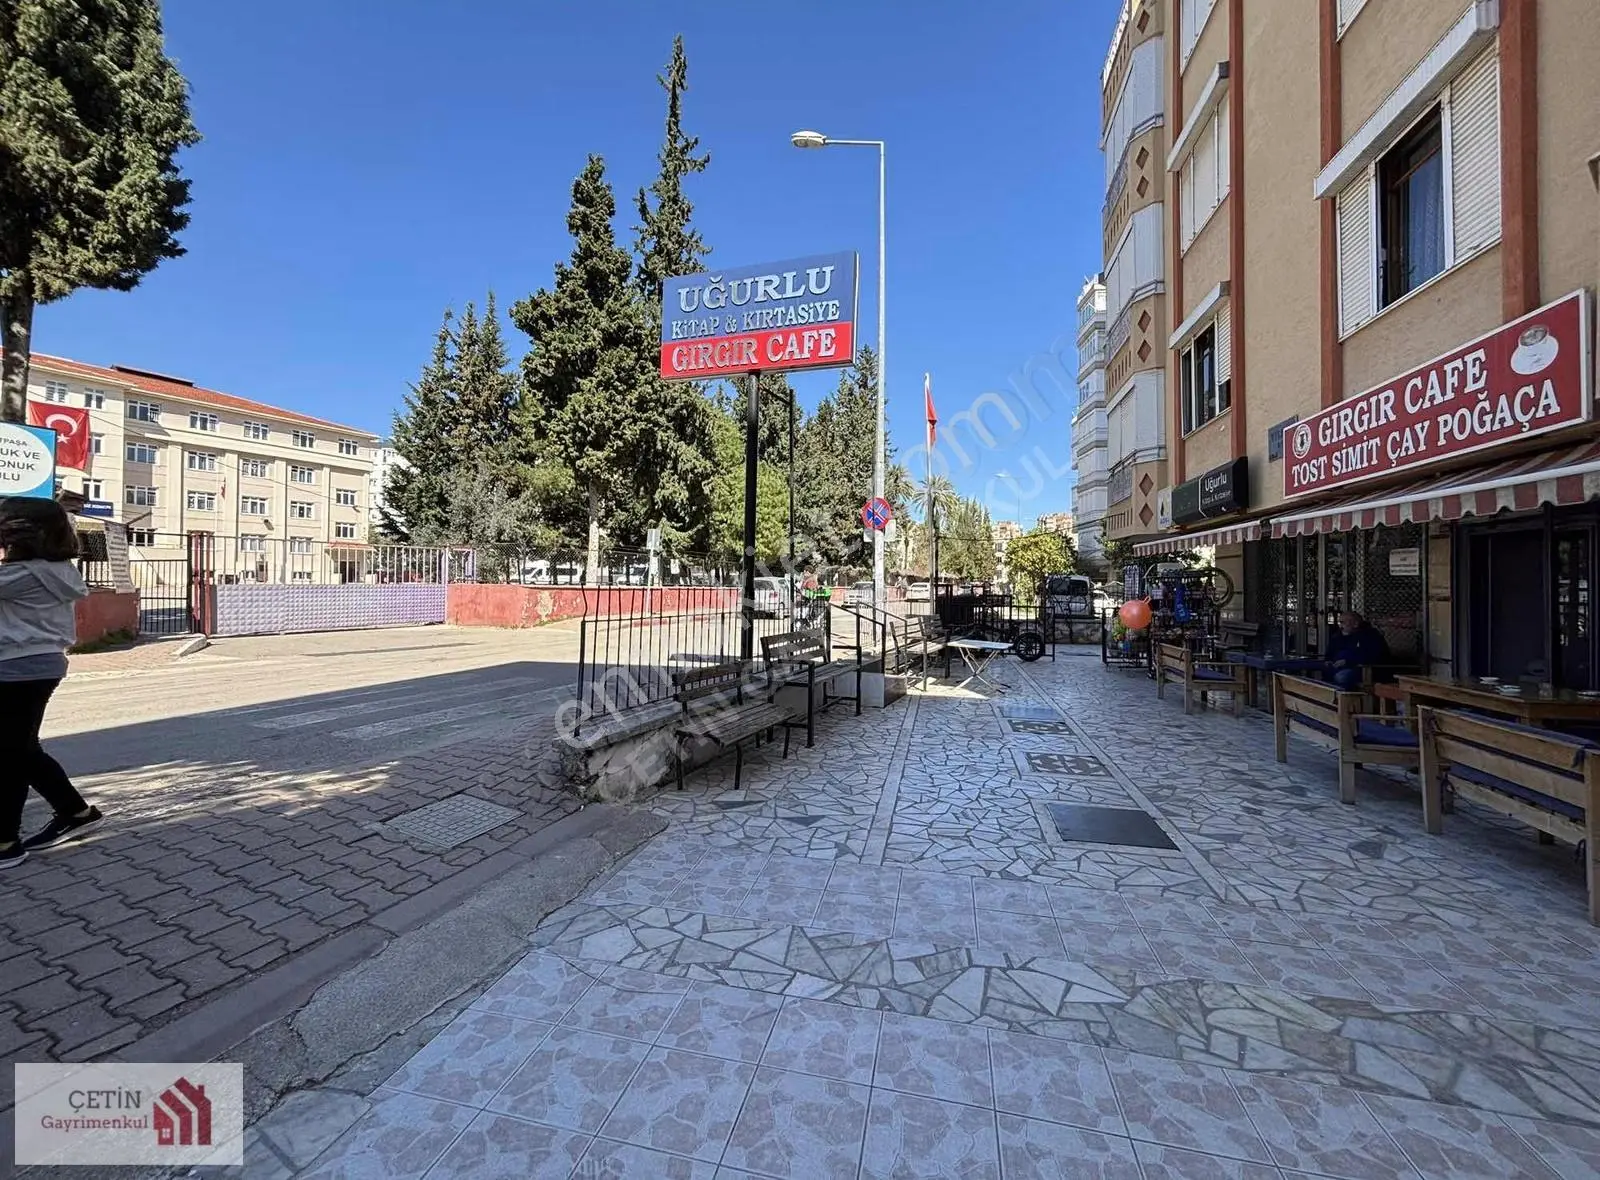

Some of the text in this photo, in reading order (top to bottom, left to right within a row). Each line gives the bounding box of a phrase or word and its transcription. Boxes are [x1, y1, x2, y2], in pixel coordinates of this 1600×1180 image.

[678, 265, 834, 313] UĞURLU
[724, 315, 737, 333] &
[671, 328, 836, 372] GIRGIR CAFE
[1318, 390, 1396, 447] GIRGIR
[1404, 348, 1488, 413] CAFE
[23, 451, 40, 460] VE
[1291, 456, 1328, 487] TOST
[1332, 437, 1381, 477] SİMİT
[1387, 420, 1431, 466] ÇAY
[1437, 378, 1561, 446] POĞAÇA
